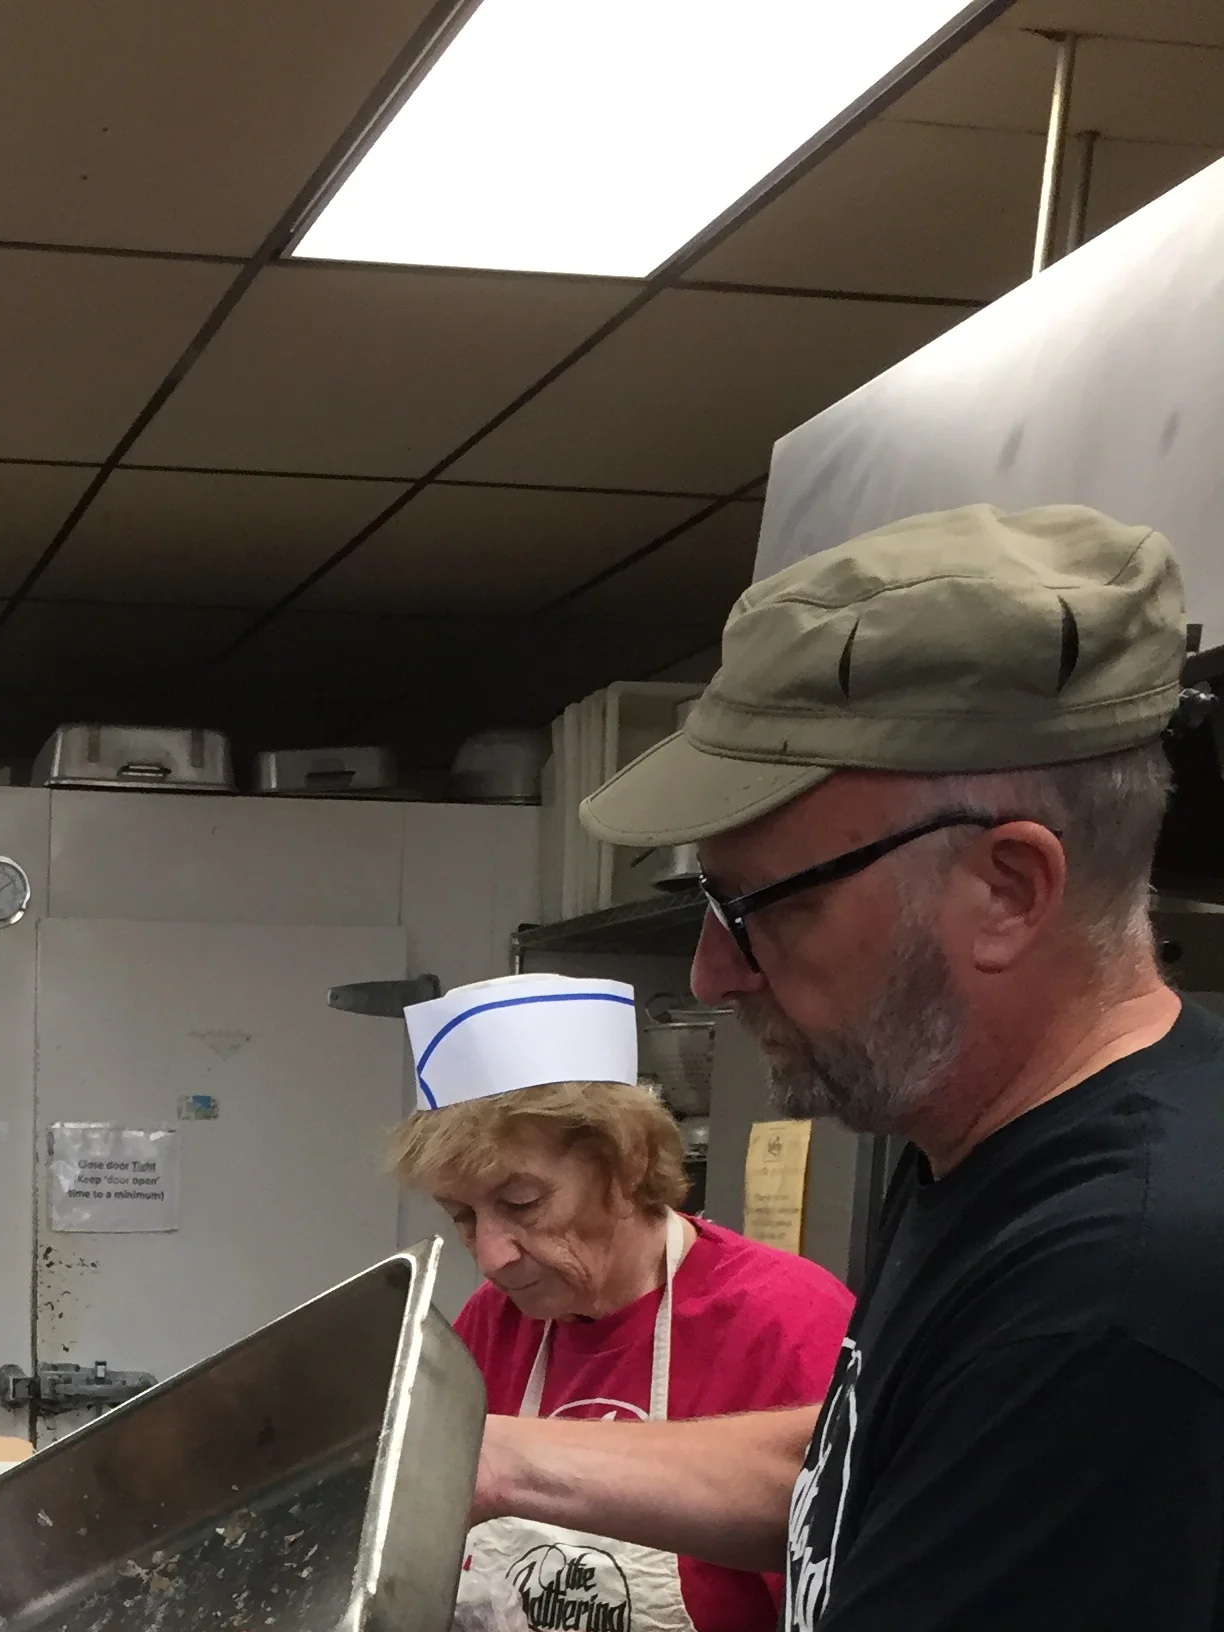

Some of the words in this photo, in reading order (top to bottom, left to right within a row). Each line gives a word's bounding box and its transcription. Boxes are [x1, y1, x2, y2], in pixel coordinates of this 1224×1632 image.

[78, 1160, 104, 1170] Close
[106, 1161, 129, 1170] door
[77, 1175, 102, 1185] Keep
[68, 1189, 90, 1198] time
[93, 1190, 103, 1198] to
[565, 1553, 597, 1592] the
